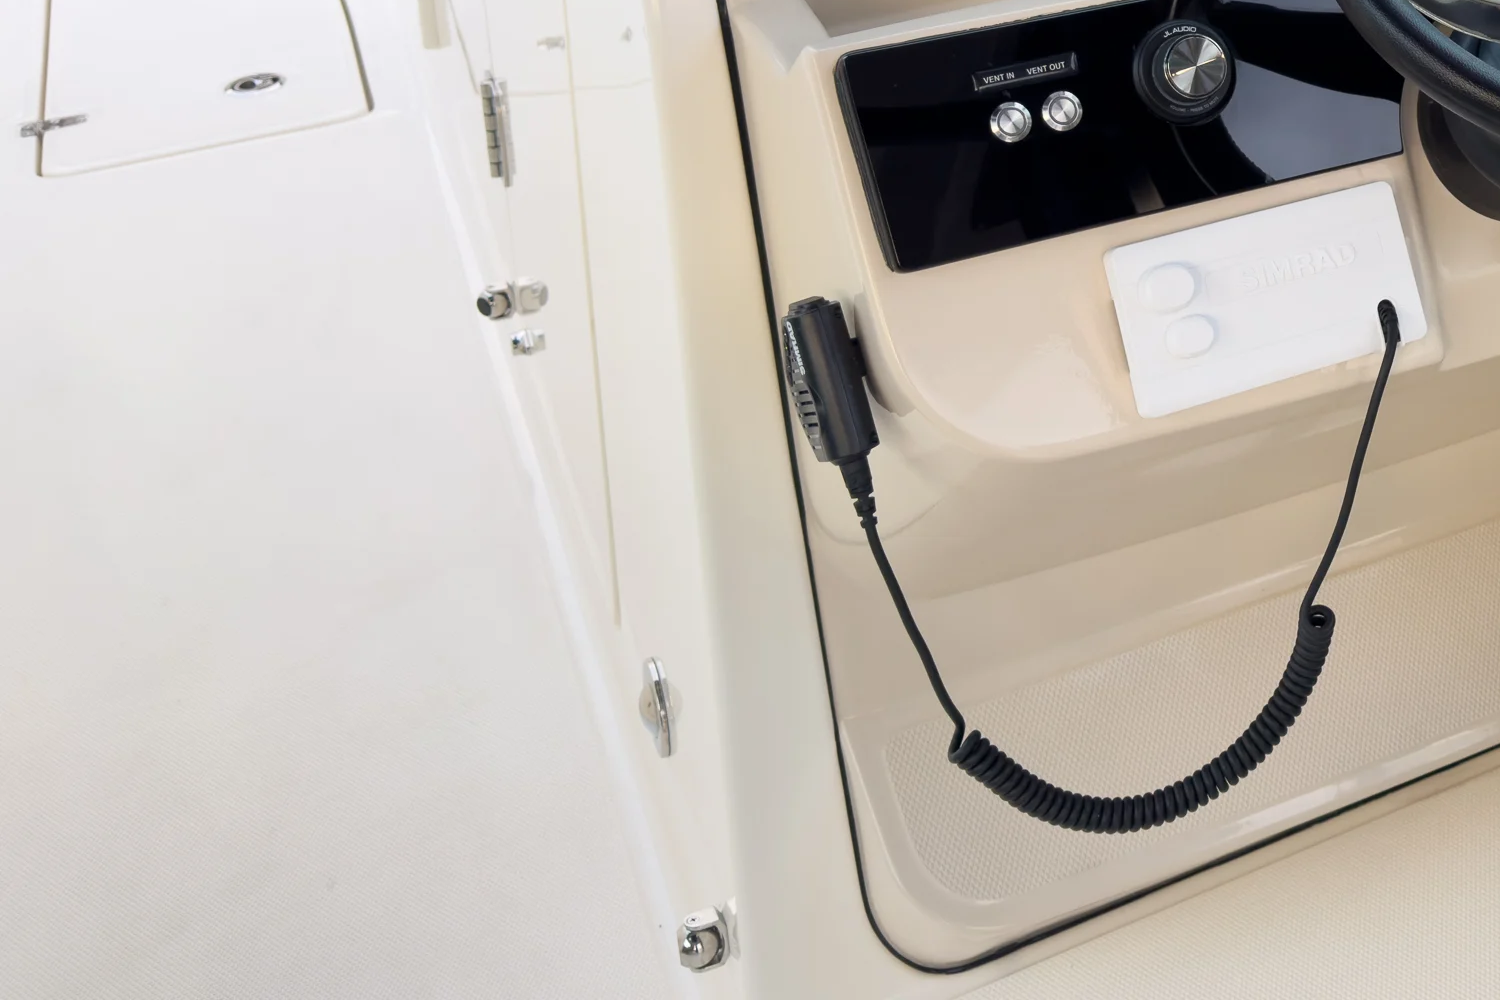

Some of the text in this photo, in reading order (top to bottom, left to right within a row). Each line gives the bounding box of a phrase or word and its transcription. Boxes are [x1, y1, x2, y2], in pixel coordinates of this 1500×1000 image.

[1172, 26, 1196, 34] AUDIO
[1026, 61, 1065, 75] VENT OUT
[983, 74, 1004, 84] VENT
[1241, 242, 1358, 293] SIMRAD
[786, 321, 806, 376] SIMRAD
